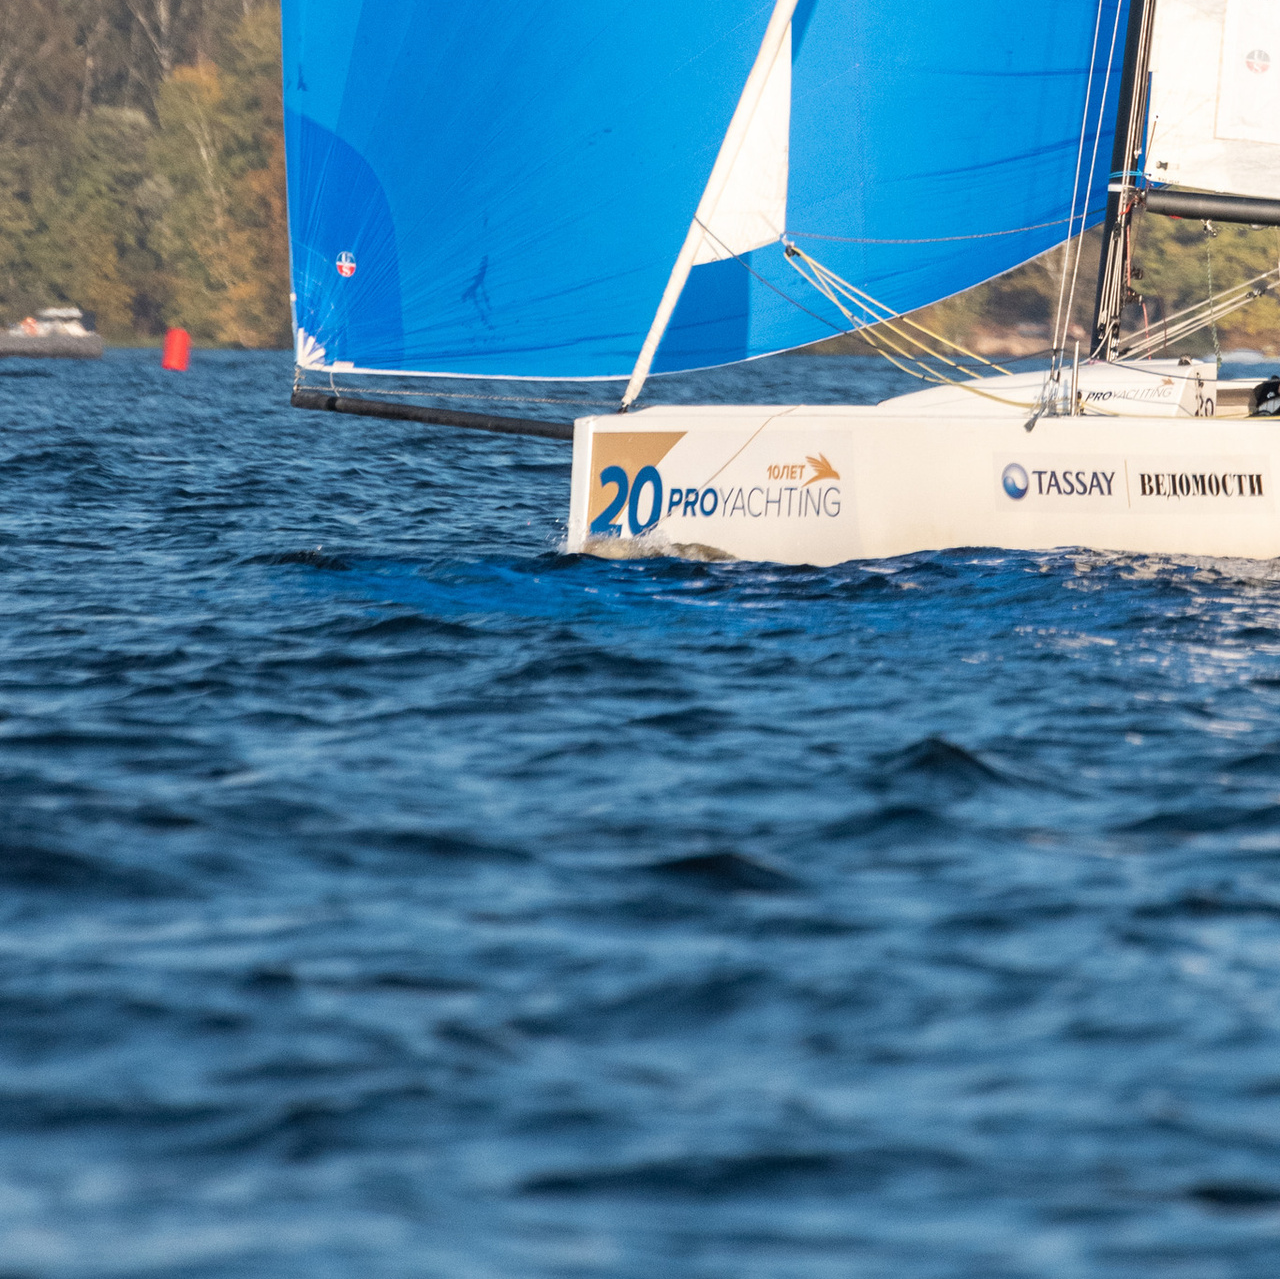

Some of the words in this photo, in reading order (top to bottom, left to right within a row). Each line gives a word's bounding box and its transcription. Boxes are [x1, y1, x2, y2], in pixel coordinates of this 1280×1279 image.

[1032, 470, 1116, 496] TASSAY
[1139, 472, 1264, 501] ВЕДОМОСТИ
[589, 464, 663, 539] 20
[667, 487, 841, 518] PROYACHTING
